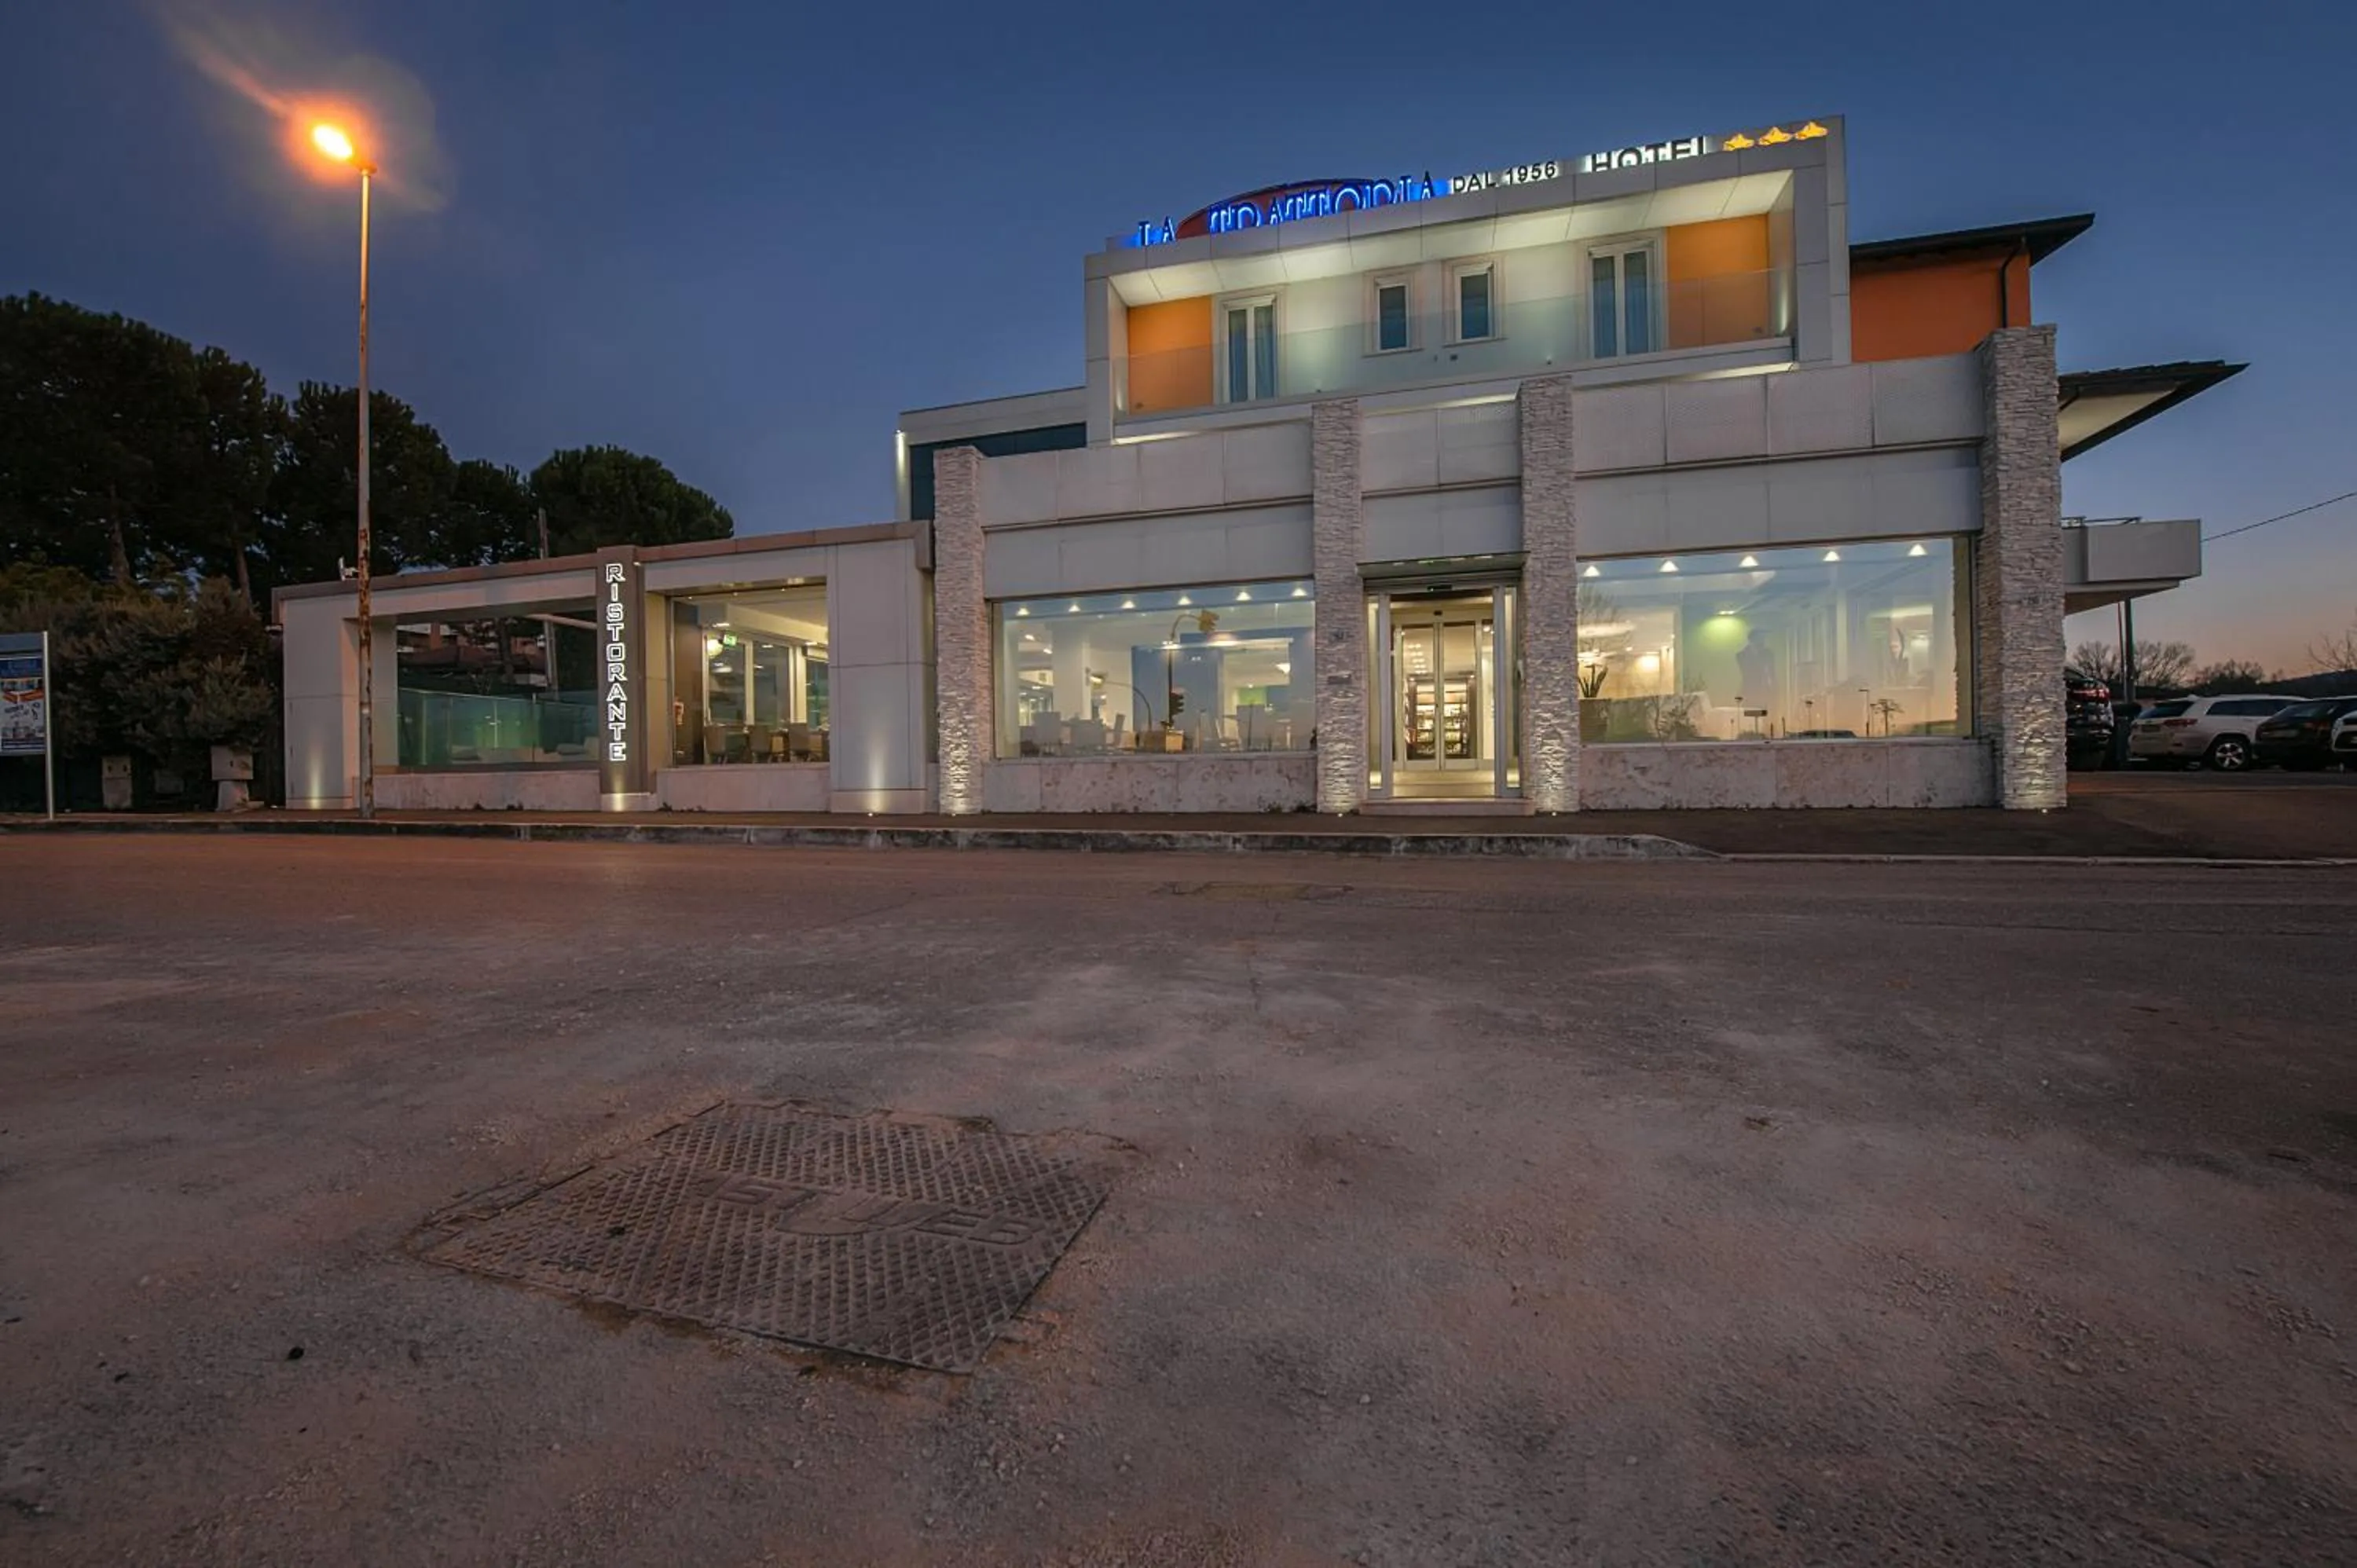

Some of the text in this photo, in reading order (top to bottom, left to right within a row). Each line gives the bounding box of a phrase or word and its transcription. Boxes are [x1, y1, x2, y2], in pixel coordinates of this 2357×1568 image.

[1453, 160, 1556, 192] DAL 1956
[605, 562, 628, 762] RISTORANTE
